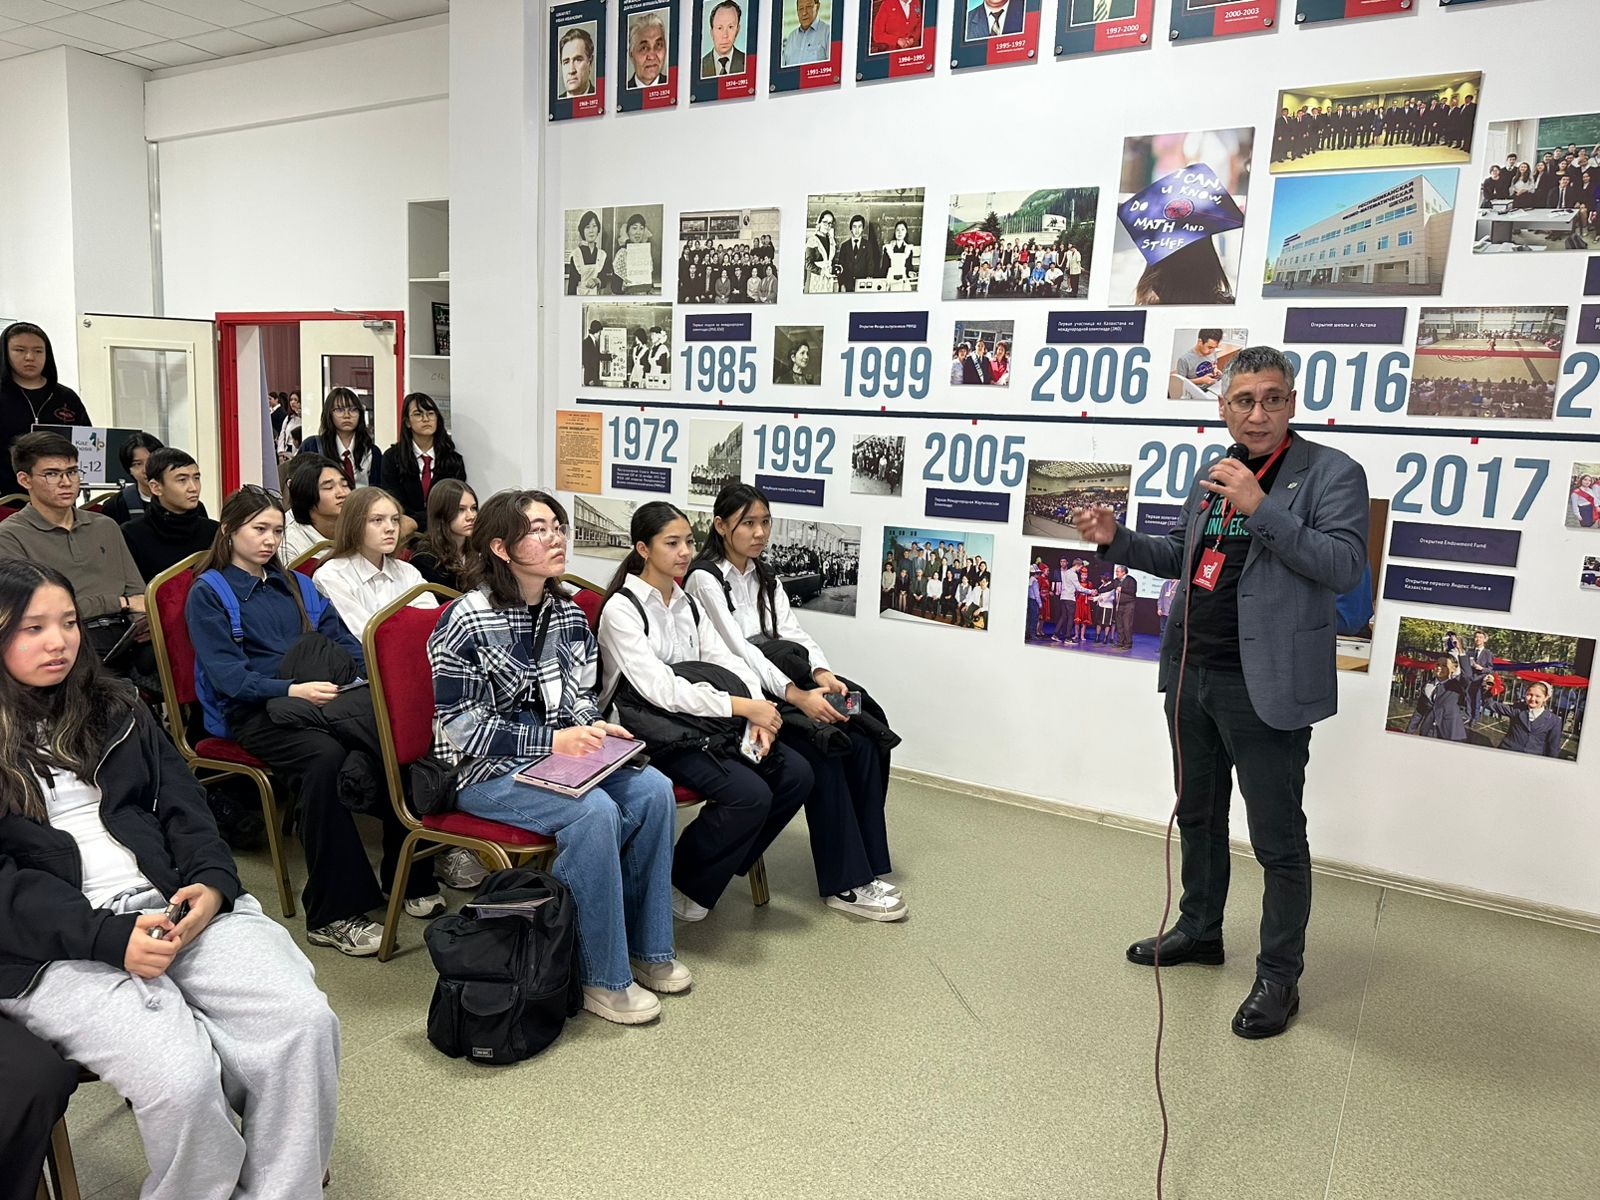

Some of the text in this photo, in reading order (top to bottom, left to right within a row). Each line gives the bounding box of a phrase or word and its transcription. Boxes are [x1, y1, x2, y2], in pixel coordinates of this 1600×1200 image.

[1225, 8, 1260, 18] 2000-2003
[1106, 24, 1139, 35] 1997-2000
[996, 40, 1026, 50] 1995-1997
[1184, 173, 1222, 191] CAN,
[1179, 186, 1222, 204] KNOW,
[1130, 200, 1148, 211] DO
[1134, 217, 1204, 233] MATH AND
[1141, 238, 1184, 251] STUFF
[681, 346, 756, 394] 1985
[840, 346, 932, 400] 1999
[1031, 346, 1151, 404] 2006
[608, 416, 679, 463] 1972
[753, 424, 836, 474] 1992
[922, 432, 1025, 487] 2005
[1391, 452, 1550, 520] 2017
